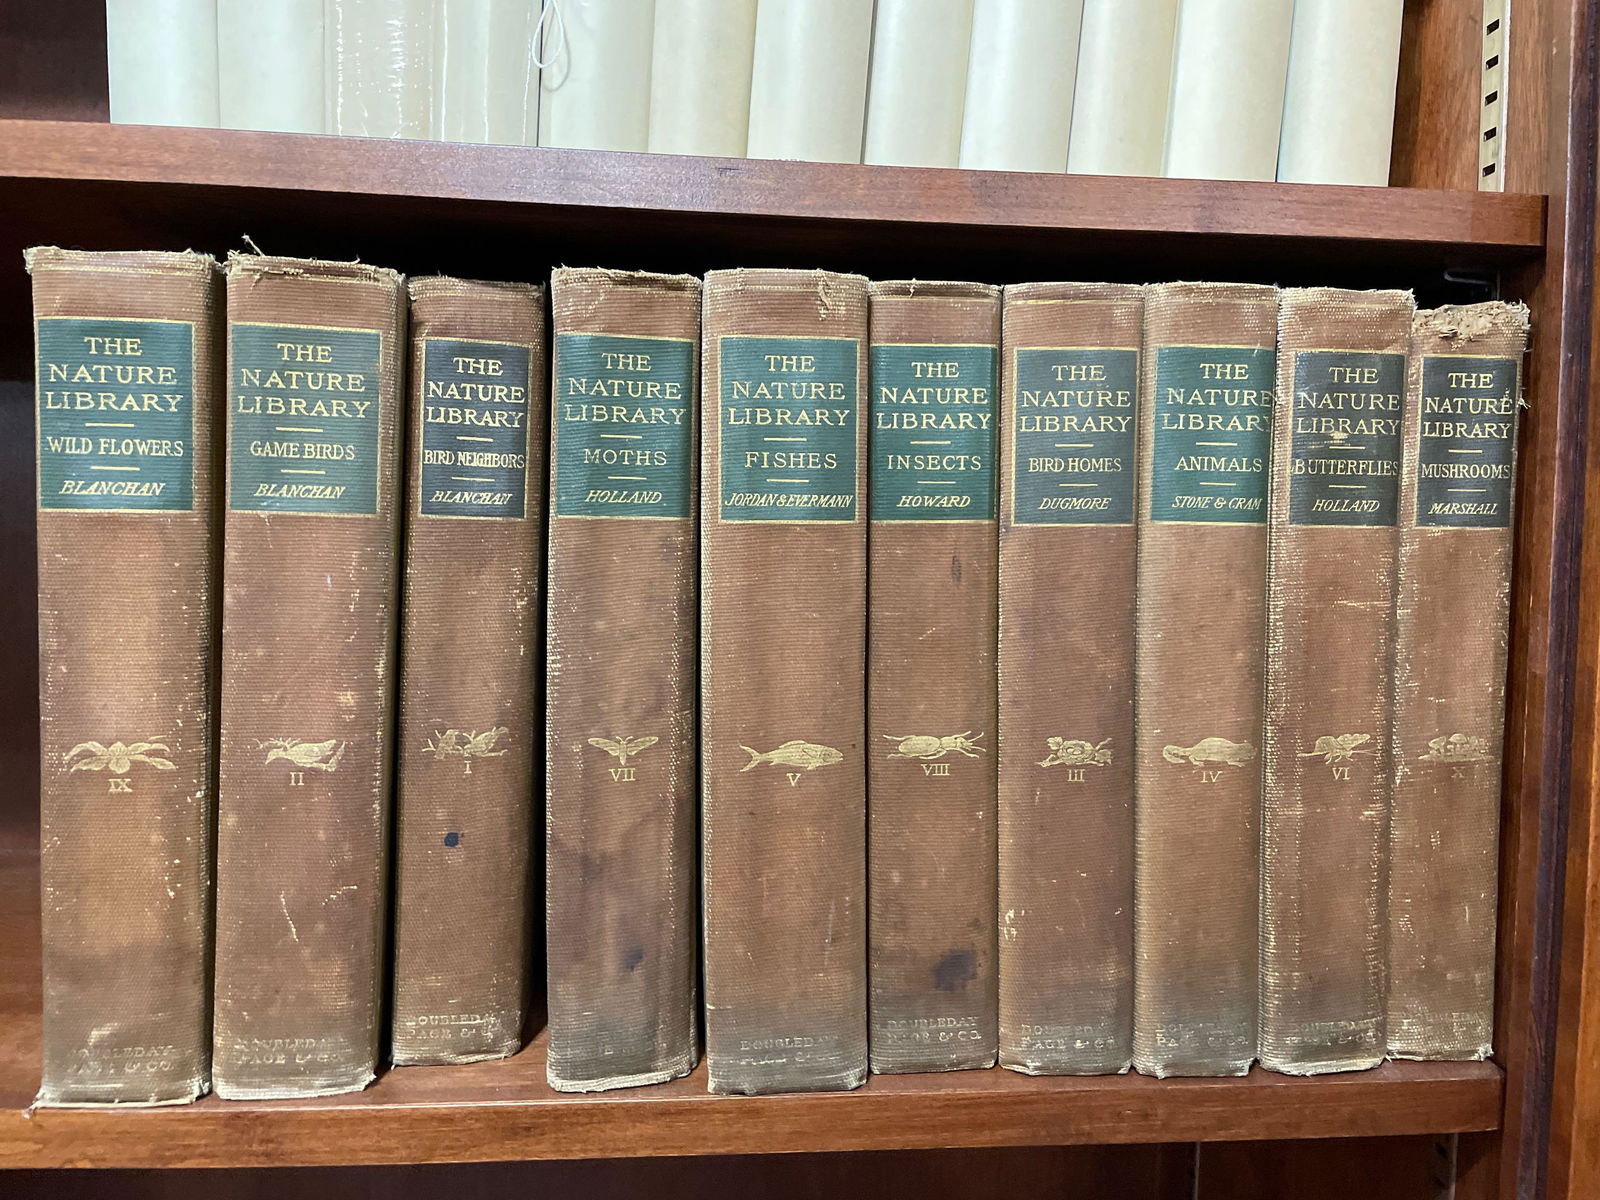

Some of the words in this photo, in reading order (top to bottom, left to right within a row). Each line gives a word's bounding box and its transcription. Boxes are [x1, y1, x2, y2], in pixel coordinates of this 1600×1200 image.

[84, 337, 143, 356] THE
[277, 343, 333, 363] THE
[453, 357, 504, 376] THE
[601, 352, 652, 371] THE
[764, 354, 816, 373] THE
[911, 362, 960, 378] THE
[49, 364, 178, 385] NATURE
[1052, 365, 1107, 381] THE
[1200, 363, 1249, 380] THE
[1329, 367, 1379, 384] THE
[241, 369, 366, 392] NATURE
[568, 377, 682, 400] NATURE
[1448, 372, 1494, 389] THE
[427, 381, 525, 404] NATURE
[732, 381, 846, 400] NATURE
[880, 387, 988, 405] NATURE
[1021, 390, 1131, 408] NATURE
[1166, 387, 1272, 407] NATURE
[45, 391, 184, 412] LIBRARY
[237, 396, 371, 418] LIBRARY
[1300, 392, 1400, 411] NATURE
[1425, 397, 1512, 415] NATURE
[426, 407, 525, 428] LIBRARY
[565, 404, 687, 425] LIBRARY
[728, 408, 850, 426] LIBRARY
[876, 412, 992, 430] LIBRARY
[1020, 415, 1133, 432] LIBRARY
[1297, 417, 1400, 435] LIBRARY
[1423, 422, 1512, 439] LIBRARY
[46, 436, 93, 455] WILD
[99, 438, 184, 457] FLOWERS
[251, 441, 300, 459] GAME
[304, 442, 356, 461] BIRDS
[423, 450, 455, 465] BIRD
[456, 451, 525, 468] NEIGHBORS
[583, 448, 667, 466] MOTHS
[745, 452, 838, 469] FISHES
[887, 455, 982, 471] INSECTS
[1028, 457, 1065, 473] BIRD
[1067, 457, 1122, 473] HOMES
[1174, 456, 1263, 473] ANIMALS
[1293, 459, 1398, 476] BUTTERFLIES
[1422, 464, 1511, 479] MUSHROOMS
[59, 481, 165, 497] BLANCHAN
[254, 483, 346, 499] BLANCHAN
[429, 490, 513, 505] BLANCHAN
[585, 490, 663, 504] HOLLAND
[896, 495, 971, 508] HOWARD
[1038, 498, 1112, 510] DUGMORE
[1172, 496, 1214, 508] STONE
[1214, 498, 1226, 508] &
[1228, 497, 1262, 510] CRAM
[1312, 499, 1380, 513] HOLLAND
[1428, 503, 1498, 515] MARSHALL
[289, 772, 305, 786] II
[608, 767, 636, 782] VII
[920, 764, 950, 777] VIII
[1067, 769, 1085, 783] III
[1200, 771, 1222, 783] IV
[1331, 767, 1350, 781] VI
[108, 778, 132, 793] IX
[786, 773, 801, 787] V
